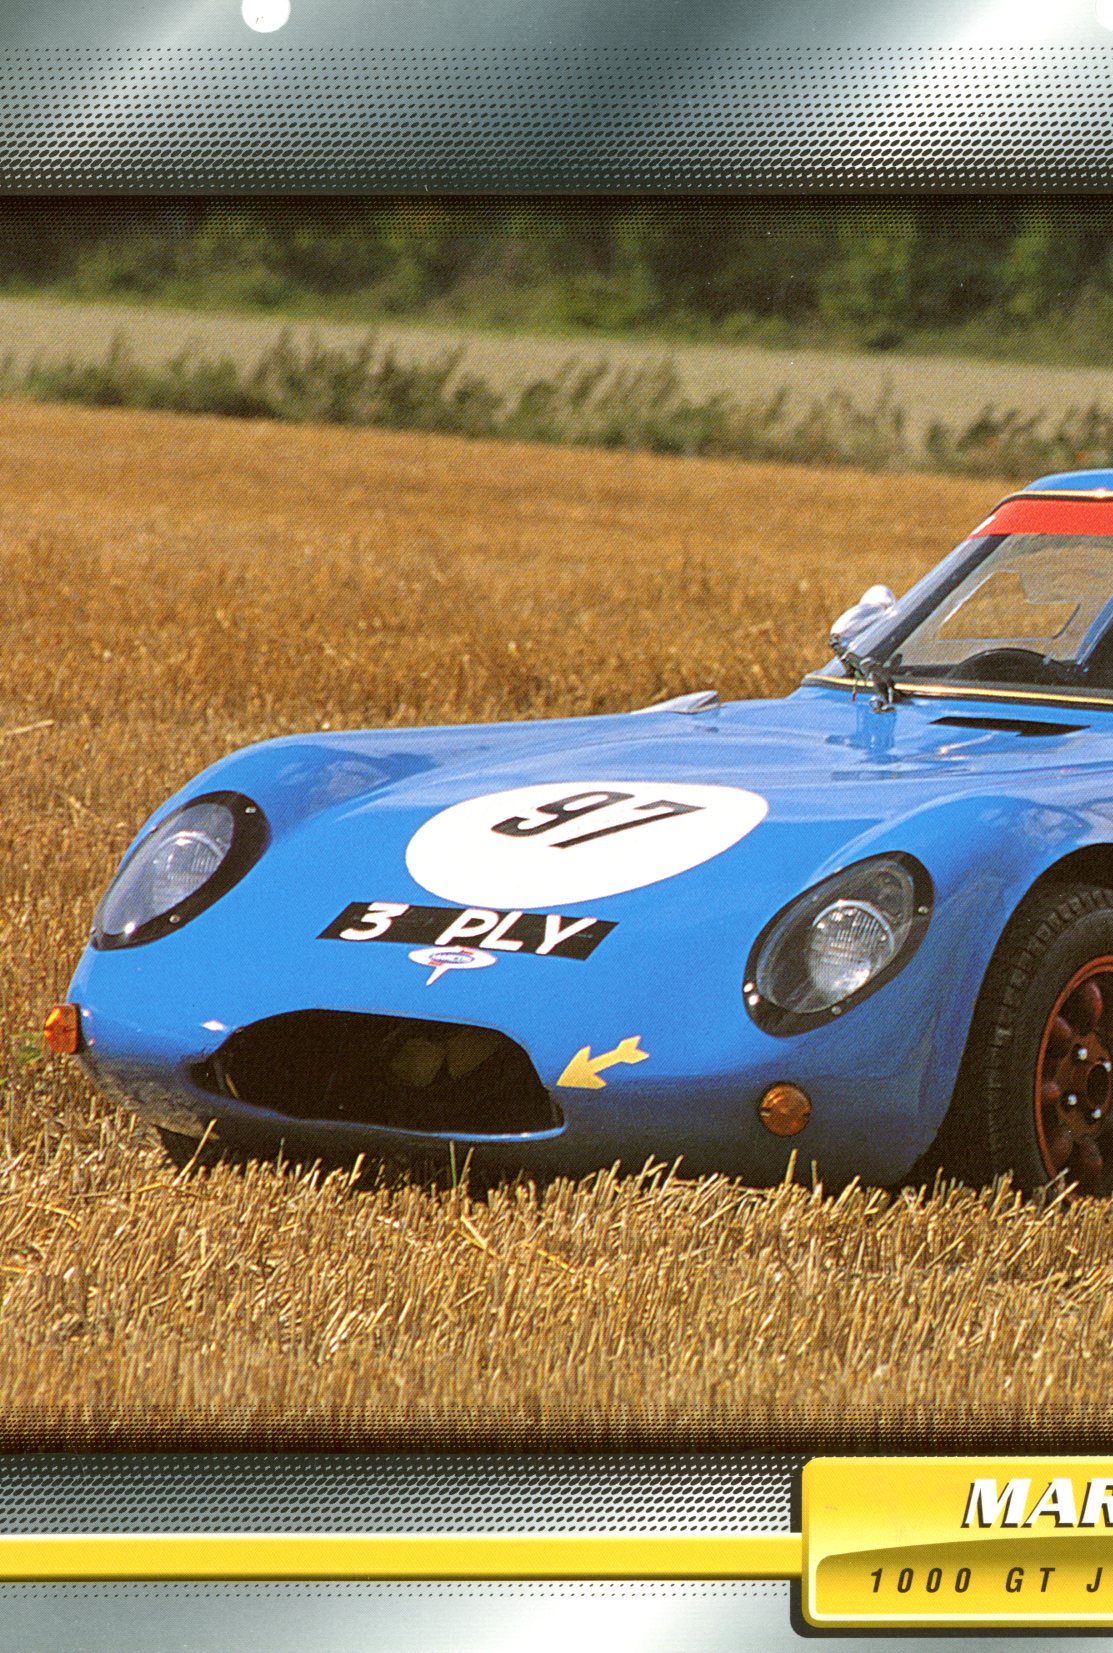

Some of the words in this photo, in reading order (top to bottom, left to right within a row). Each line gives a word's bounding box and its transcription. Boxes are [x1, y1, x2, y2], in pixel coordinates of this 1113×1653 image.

[491, 790, 707, 848] 97
[339, 902, 409, 941] 3
[434, 908, 598, 955] PLY
[869, 1567, 973, 1593] 1000
[1006, 1567, 1057, 1593] GT
